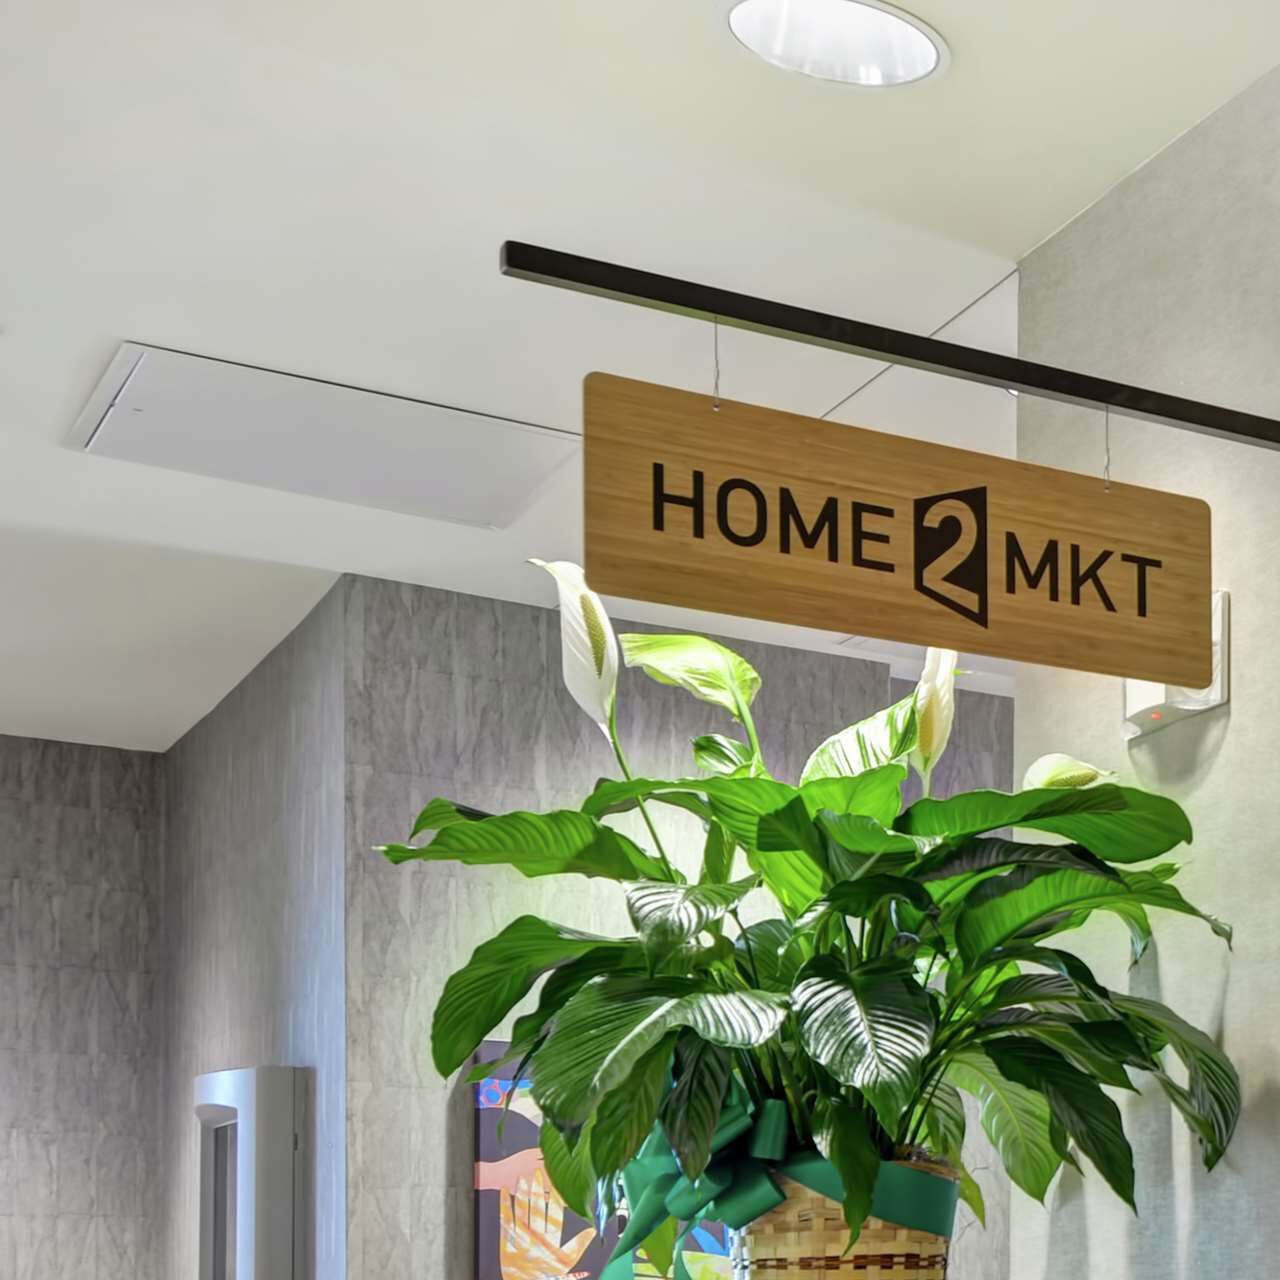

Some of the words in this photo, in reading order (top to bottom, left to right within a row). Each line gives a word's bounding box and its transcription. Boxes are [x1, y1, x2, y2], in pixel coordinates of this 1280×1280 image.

[652, 462, 896, 574] HOME
[916, 489, 988, 626] 2
[1004, 530, 1163, 619] MKT
